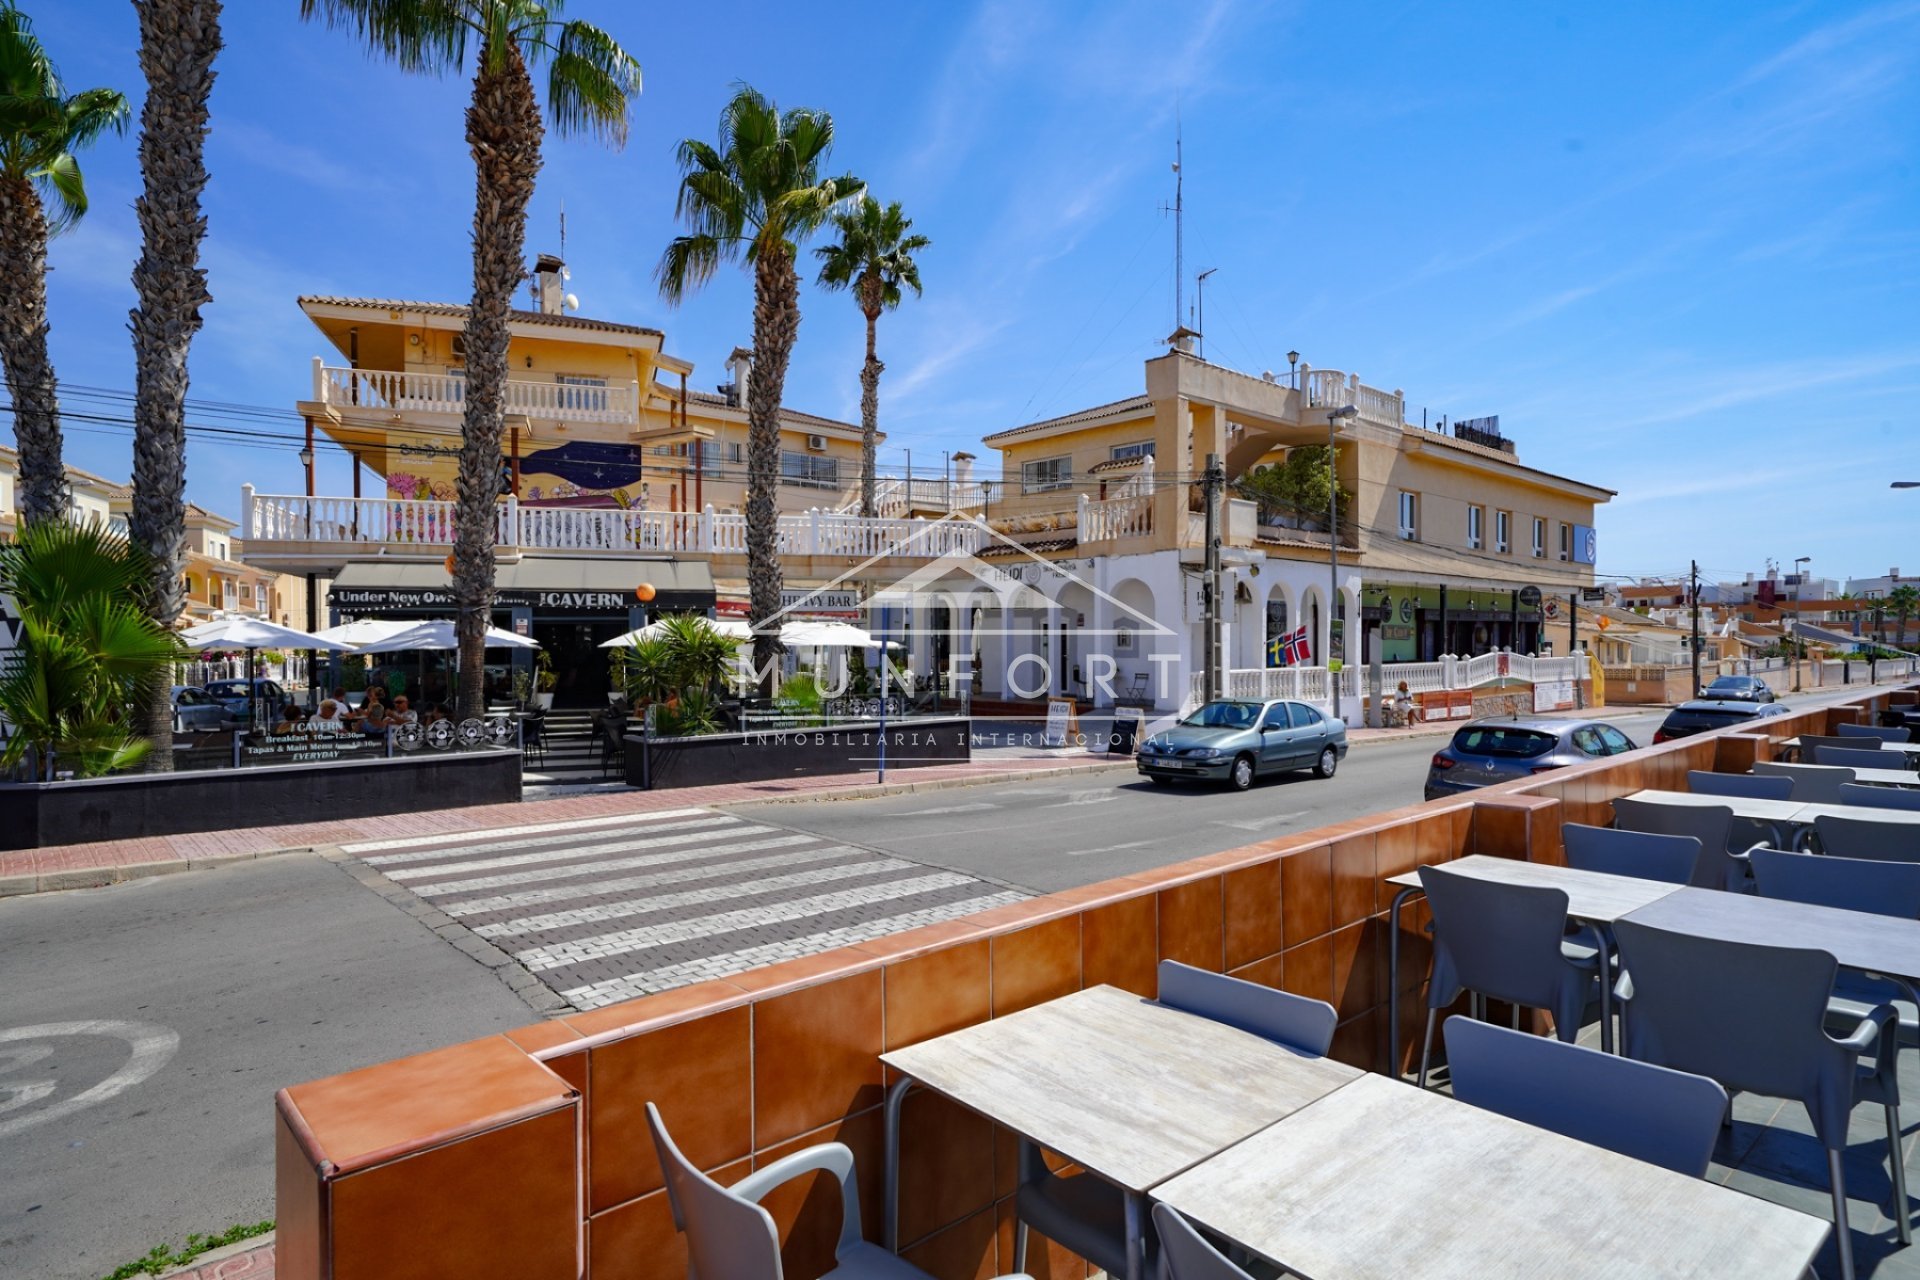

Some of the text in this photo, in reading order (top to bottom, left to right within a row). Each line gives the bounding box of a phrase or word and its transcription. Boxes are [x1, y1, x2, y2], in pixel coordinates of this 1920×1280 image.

[340, 591, 386, 602] Under
[388, 591, 420, 603] New
[547, 592, 624, 606] CAVERN
[827, 595, 851, 607] BAR
[297, 721, 344, 732] CAVERN
[265, 734, 308, 743] Breakfast
[247, 746, 275, 754] Tapas
[286, 744, 308, 752] Main
[293, 751, 340, 760] EVERYDAY
